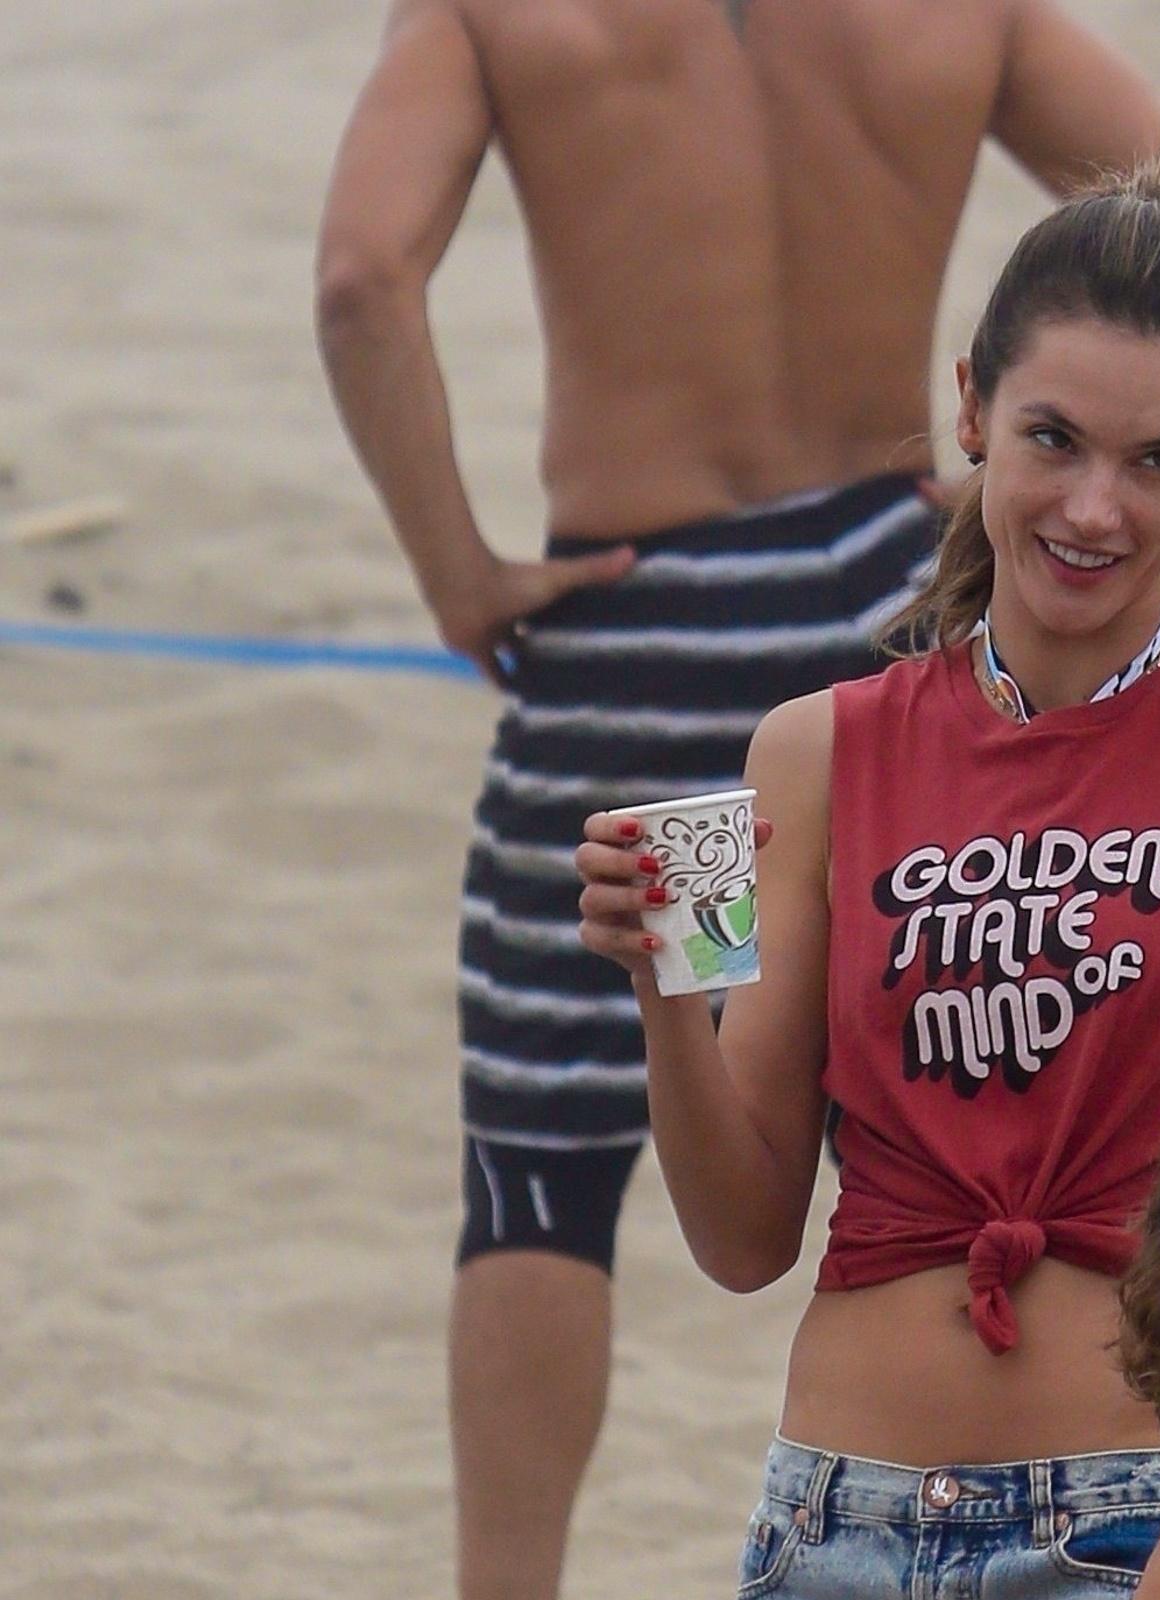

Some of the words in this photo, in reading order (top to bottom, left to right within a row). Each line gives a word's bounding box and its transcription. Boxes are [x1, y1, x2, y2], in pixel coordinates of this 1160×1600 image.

[892, 889, 1099, 979] STATE
[1073, 940, 1145, 996] OF
[912, 975, 1076, 1080] MIND
